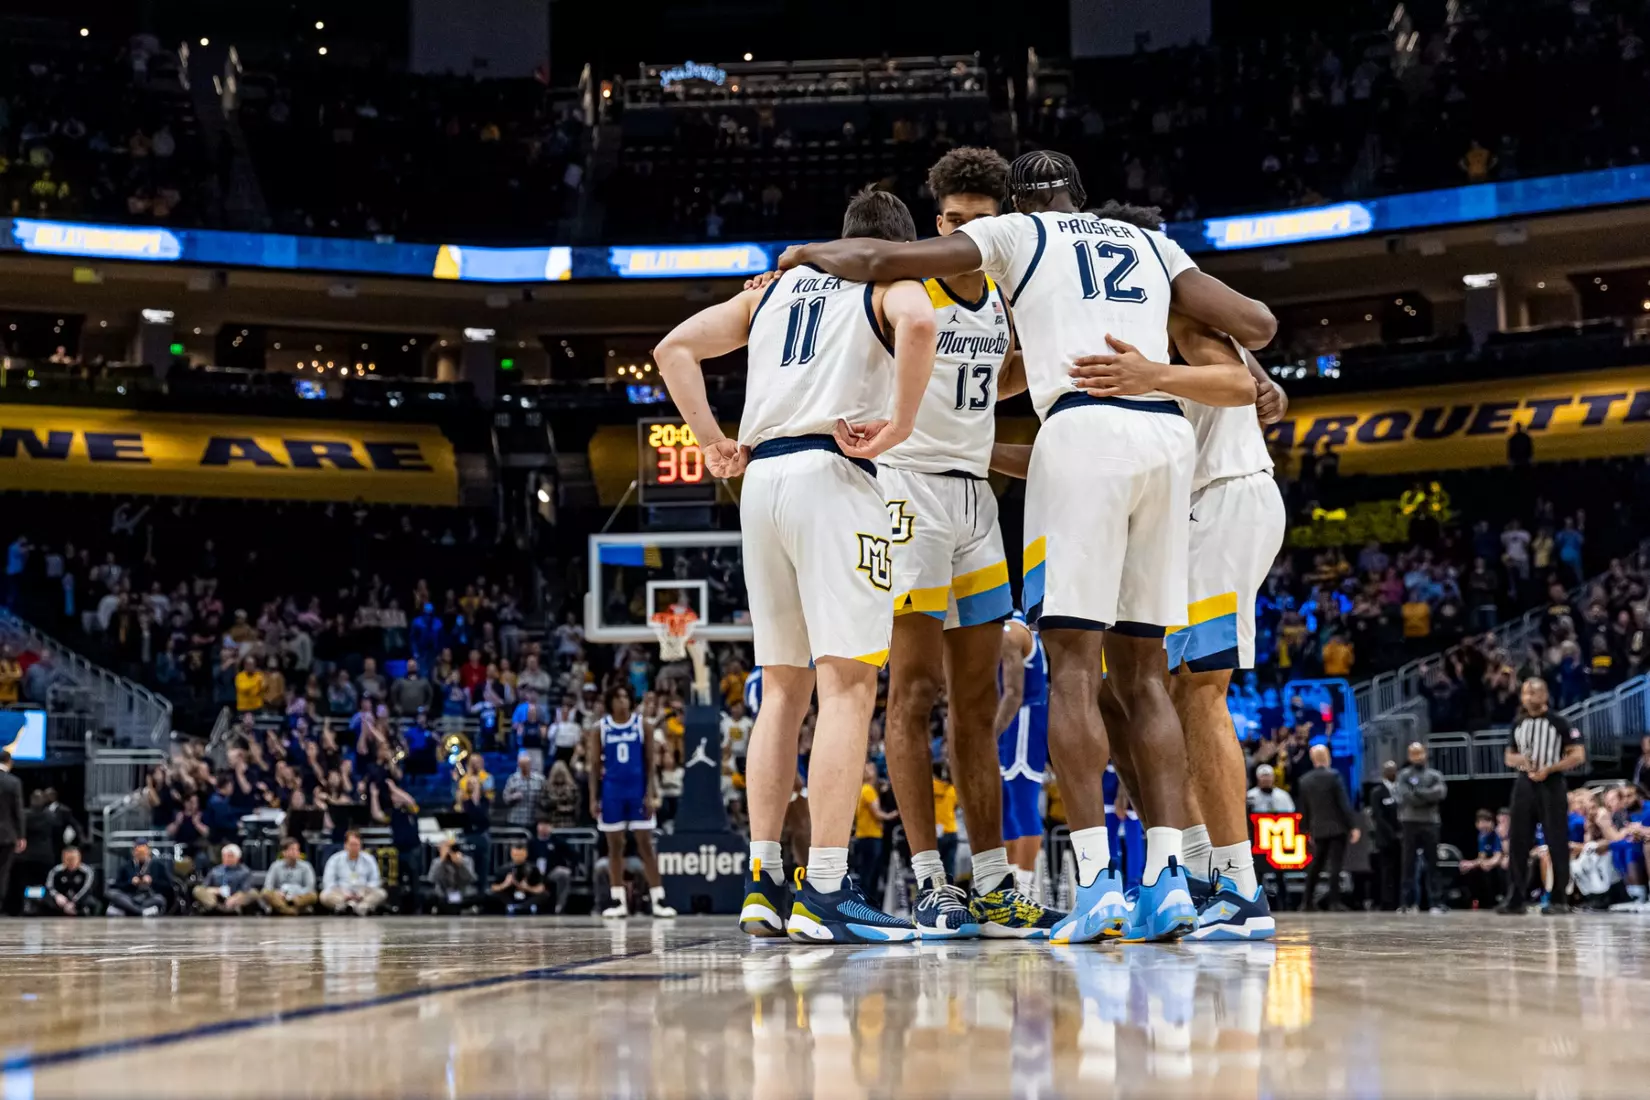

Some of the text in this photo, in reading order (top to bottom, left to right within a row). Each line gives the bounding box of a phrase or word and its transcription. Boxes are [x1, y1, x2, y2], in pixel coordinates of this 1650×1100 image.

[1057, 219, 1135, 238] PROSPER
[792, 276, 843, 293] KOLEK
[1073, 240, 1148, 304] 12
[780, 296, 826, 367] 11
[936, 331, 1008, 359] Marquette
[954, 363, 993, 410] 13
[648, 424, 699, 447] 20:0
[200, 437, 434, 472] ARE
[657, 446, 704, 483] 30
[856, 532, 892, 592] MU
[616, 742, 629, 763] 0
[1252, 813, 1312, 868] MU
[658, 844, 746, 882] meijer
